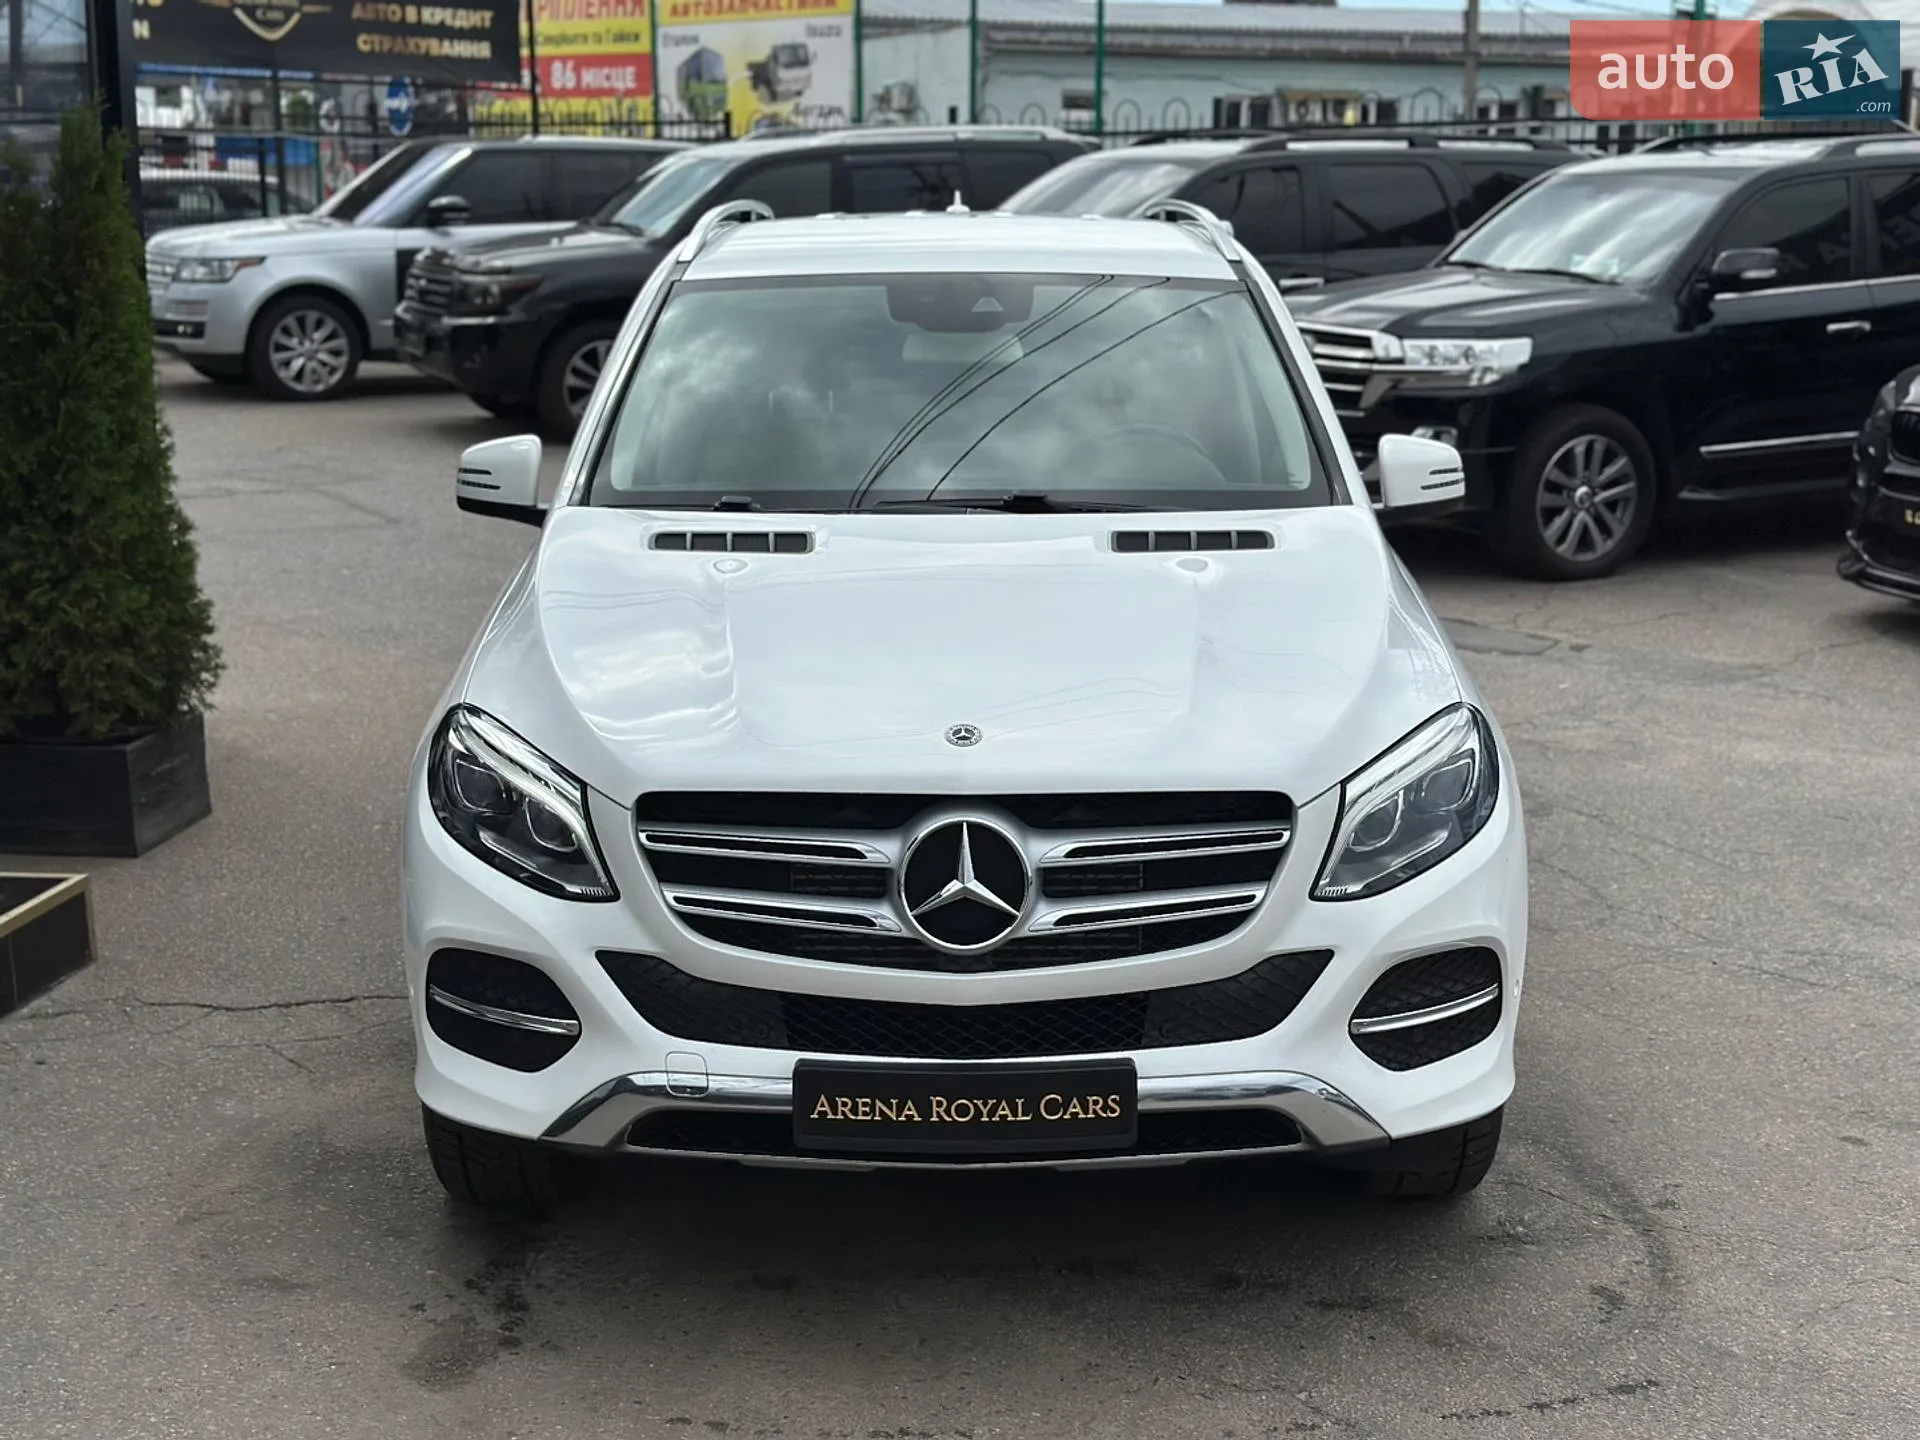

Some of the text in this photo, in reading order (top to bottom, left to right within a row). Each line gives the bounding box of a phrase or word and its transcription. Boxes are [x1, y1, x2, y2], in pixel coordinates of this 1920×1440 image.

[351, 2, 401, 23] АВТО
[420, 6, 495, 29] КРЕДИТ
[550, 60, 577, 90] 86
